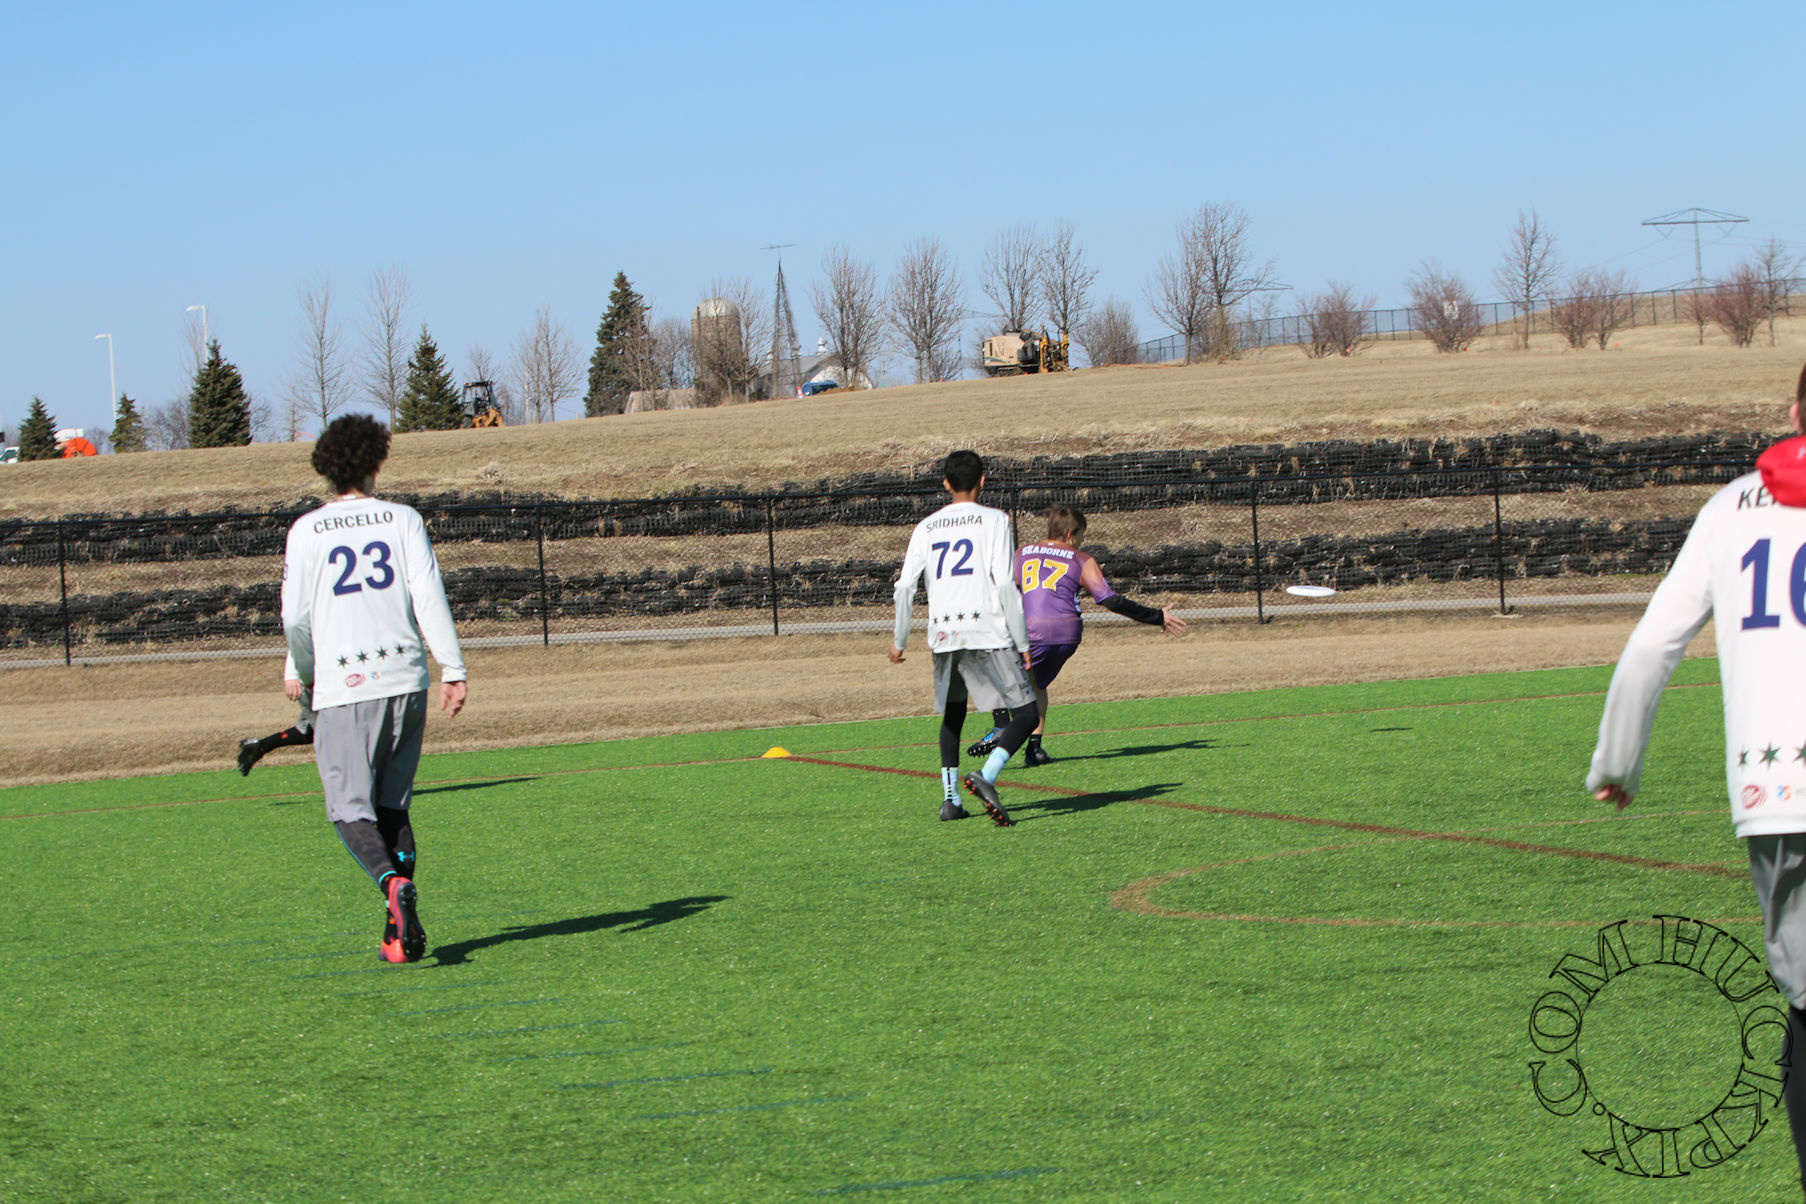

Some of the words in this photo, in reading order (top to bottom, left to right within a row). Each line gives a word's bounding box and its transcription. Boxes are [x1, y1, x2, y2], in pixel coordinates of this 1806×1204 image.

[314, 510, 393, 534] CERCELLO
[926, 515, 983, 533] SRIDHARA
[932, 538, 974, 580] 72
[1021, 545, 1074, 559] SEABORNE
[328, 541, 395, 596] 23
[1022, 558, 1069, 594] 87
